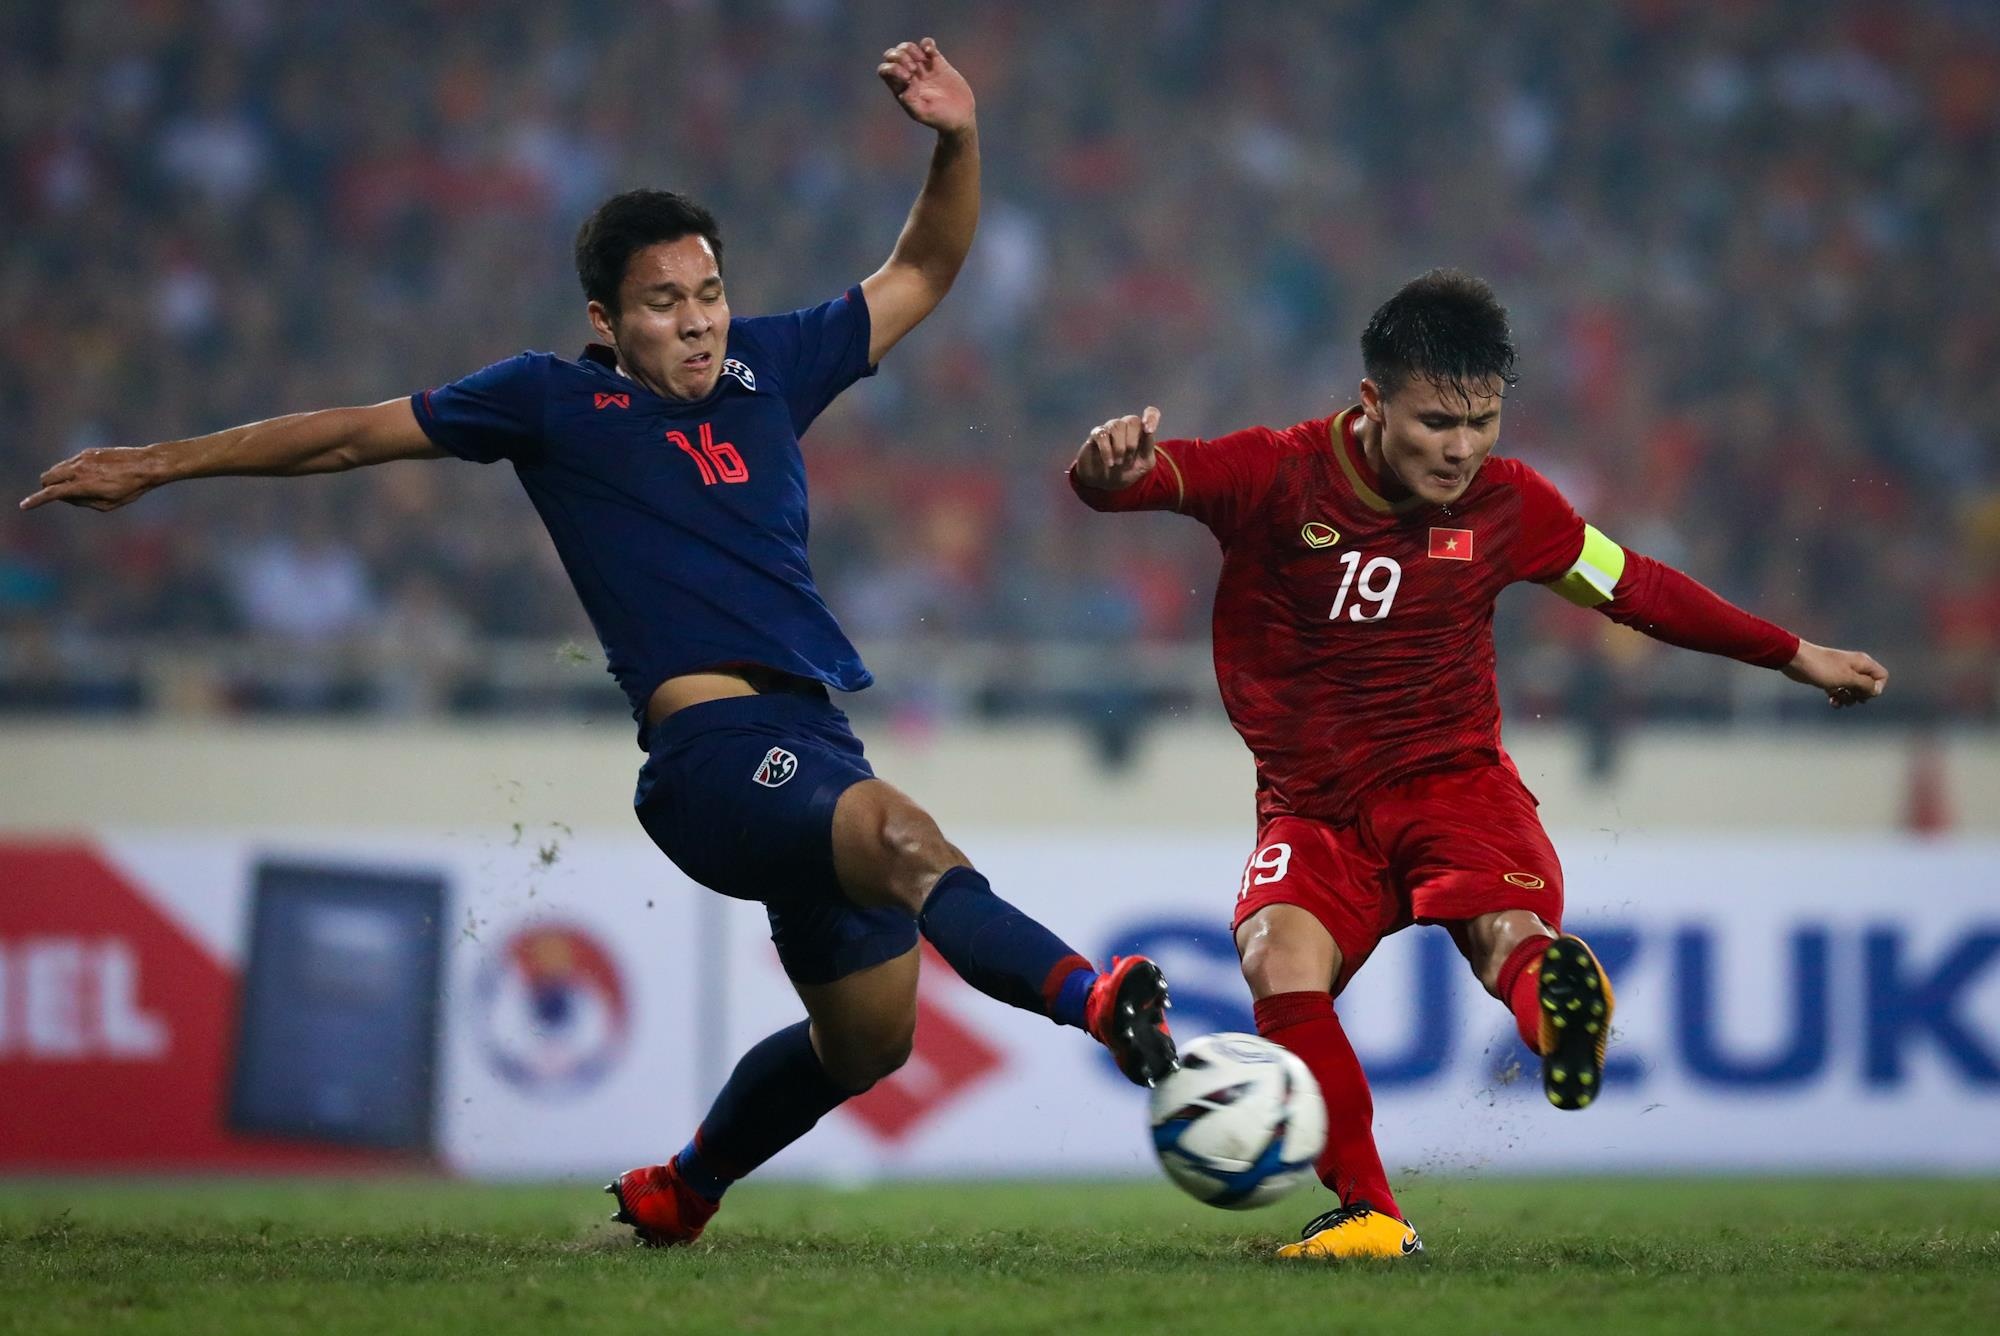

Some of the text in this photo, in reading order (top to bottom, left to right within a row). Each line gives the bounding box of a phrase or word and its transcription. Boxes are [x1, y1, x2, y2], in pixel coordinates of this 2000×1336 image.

[665, 422, 749, 486] 16
[1329, 551, 1402, 622] 19
[1242, 843, 1292, 900] 19
